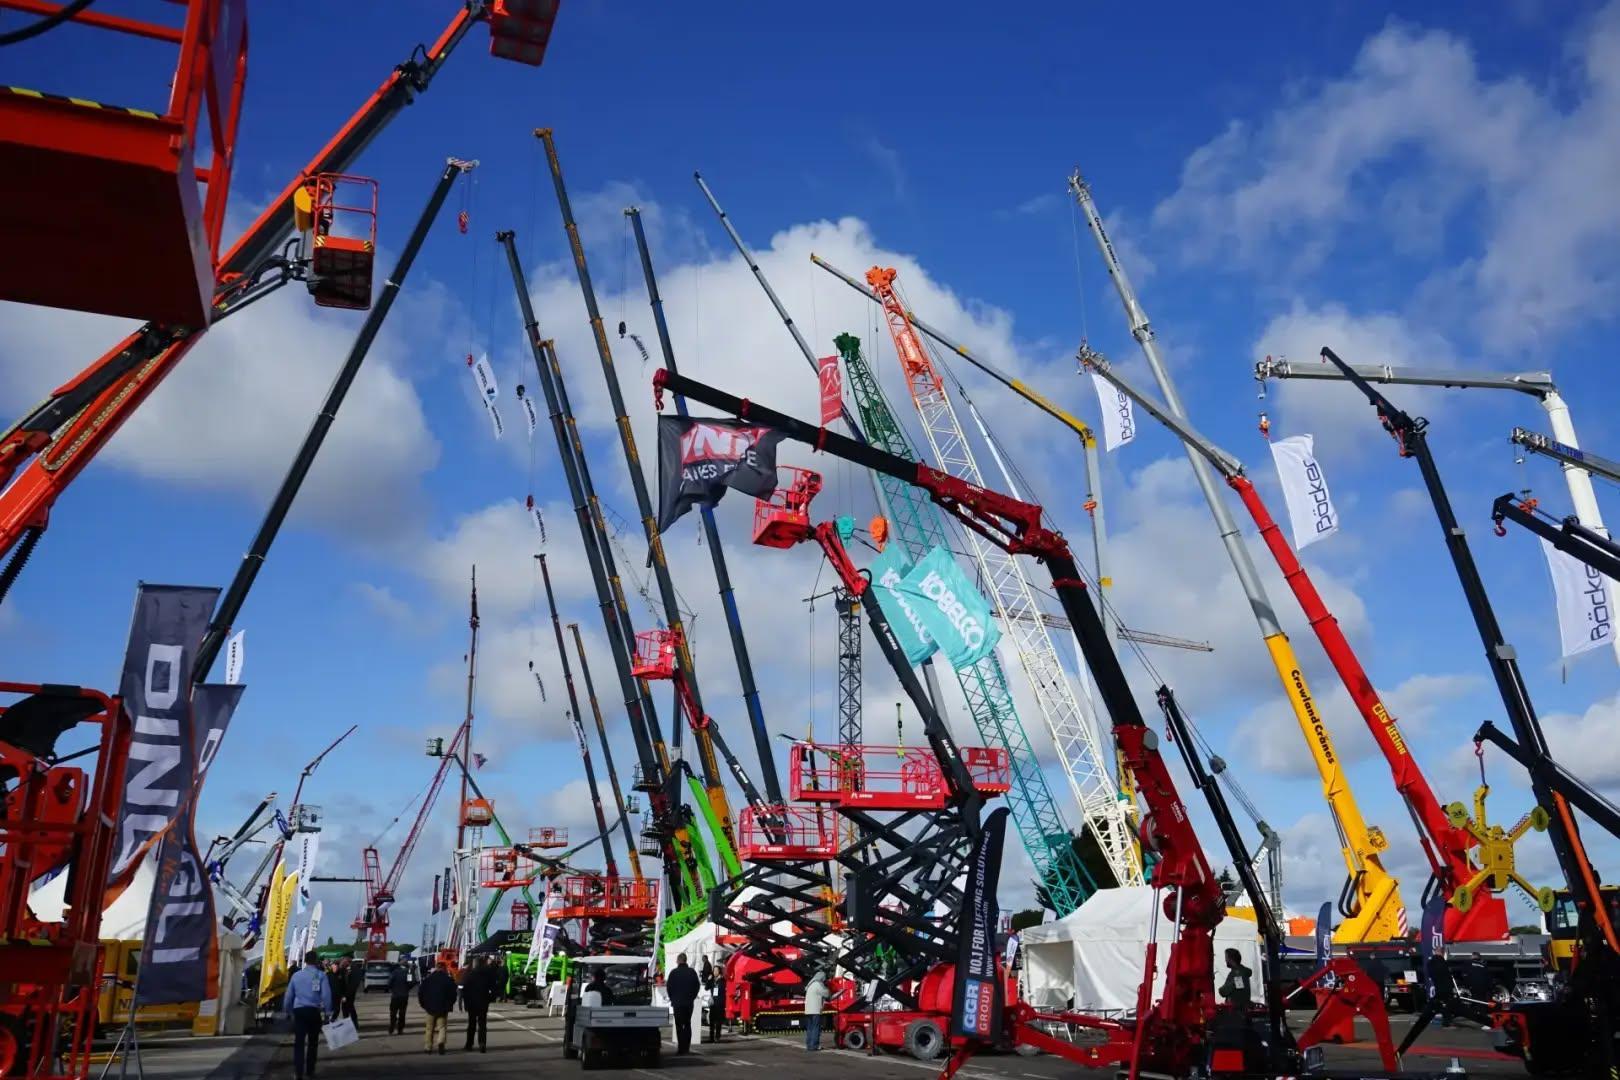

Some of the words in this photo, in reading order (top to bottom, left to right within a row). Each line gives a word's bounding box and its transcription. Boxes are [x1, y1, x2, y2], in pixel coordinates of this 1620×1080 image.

[1117, 386, 1133, 441] Böcke
[1303, 460, 1333, 533] Böcker
[918, 570, 985, 650] KOBELCO
[1584, 563, 1610, 641] Böcke
[1291, 669, 1321, 724] Crowland
[974, 888, 984, 928] LIFTING
[972, 929, 985, 951] FOR
[963, 983, 979, 1029] GGR
[979, 986, 993, 1031] GROUP
